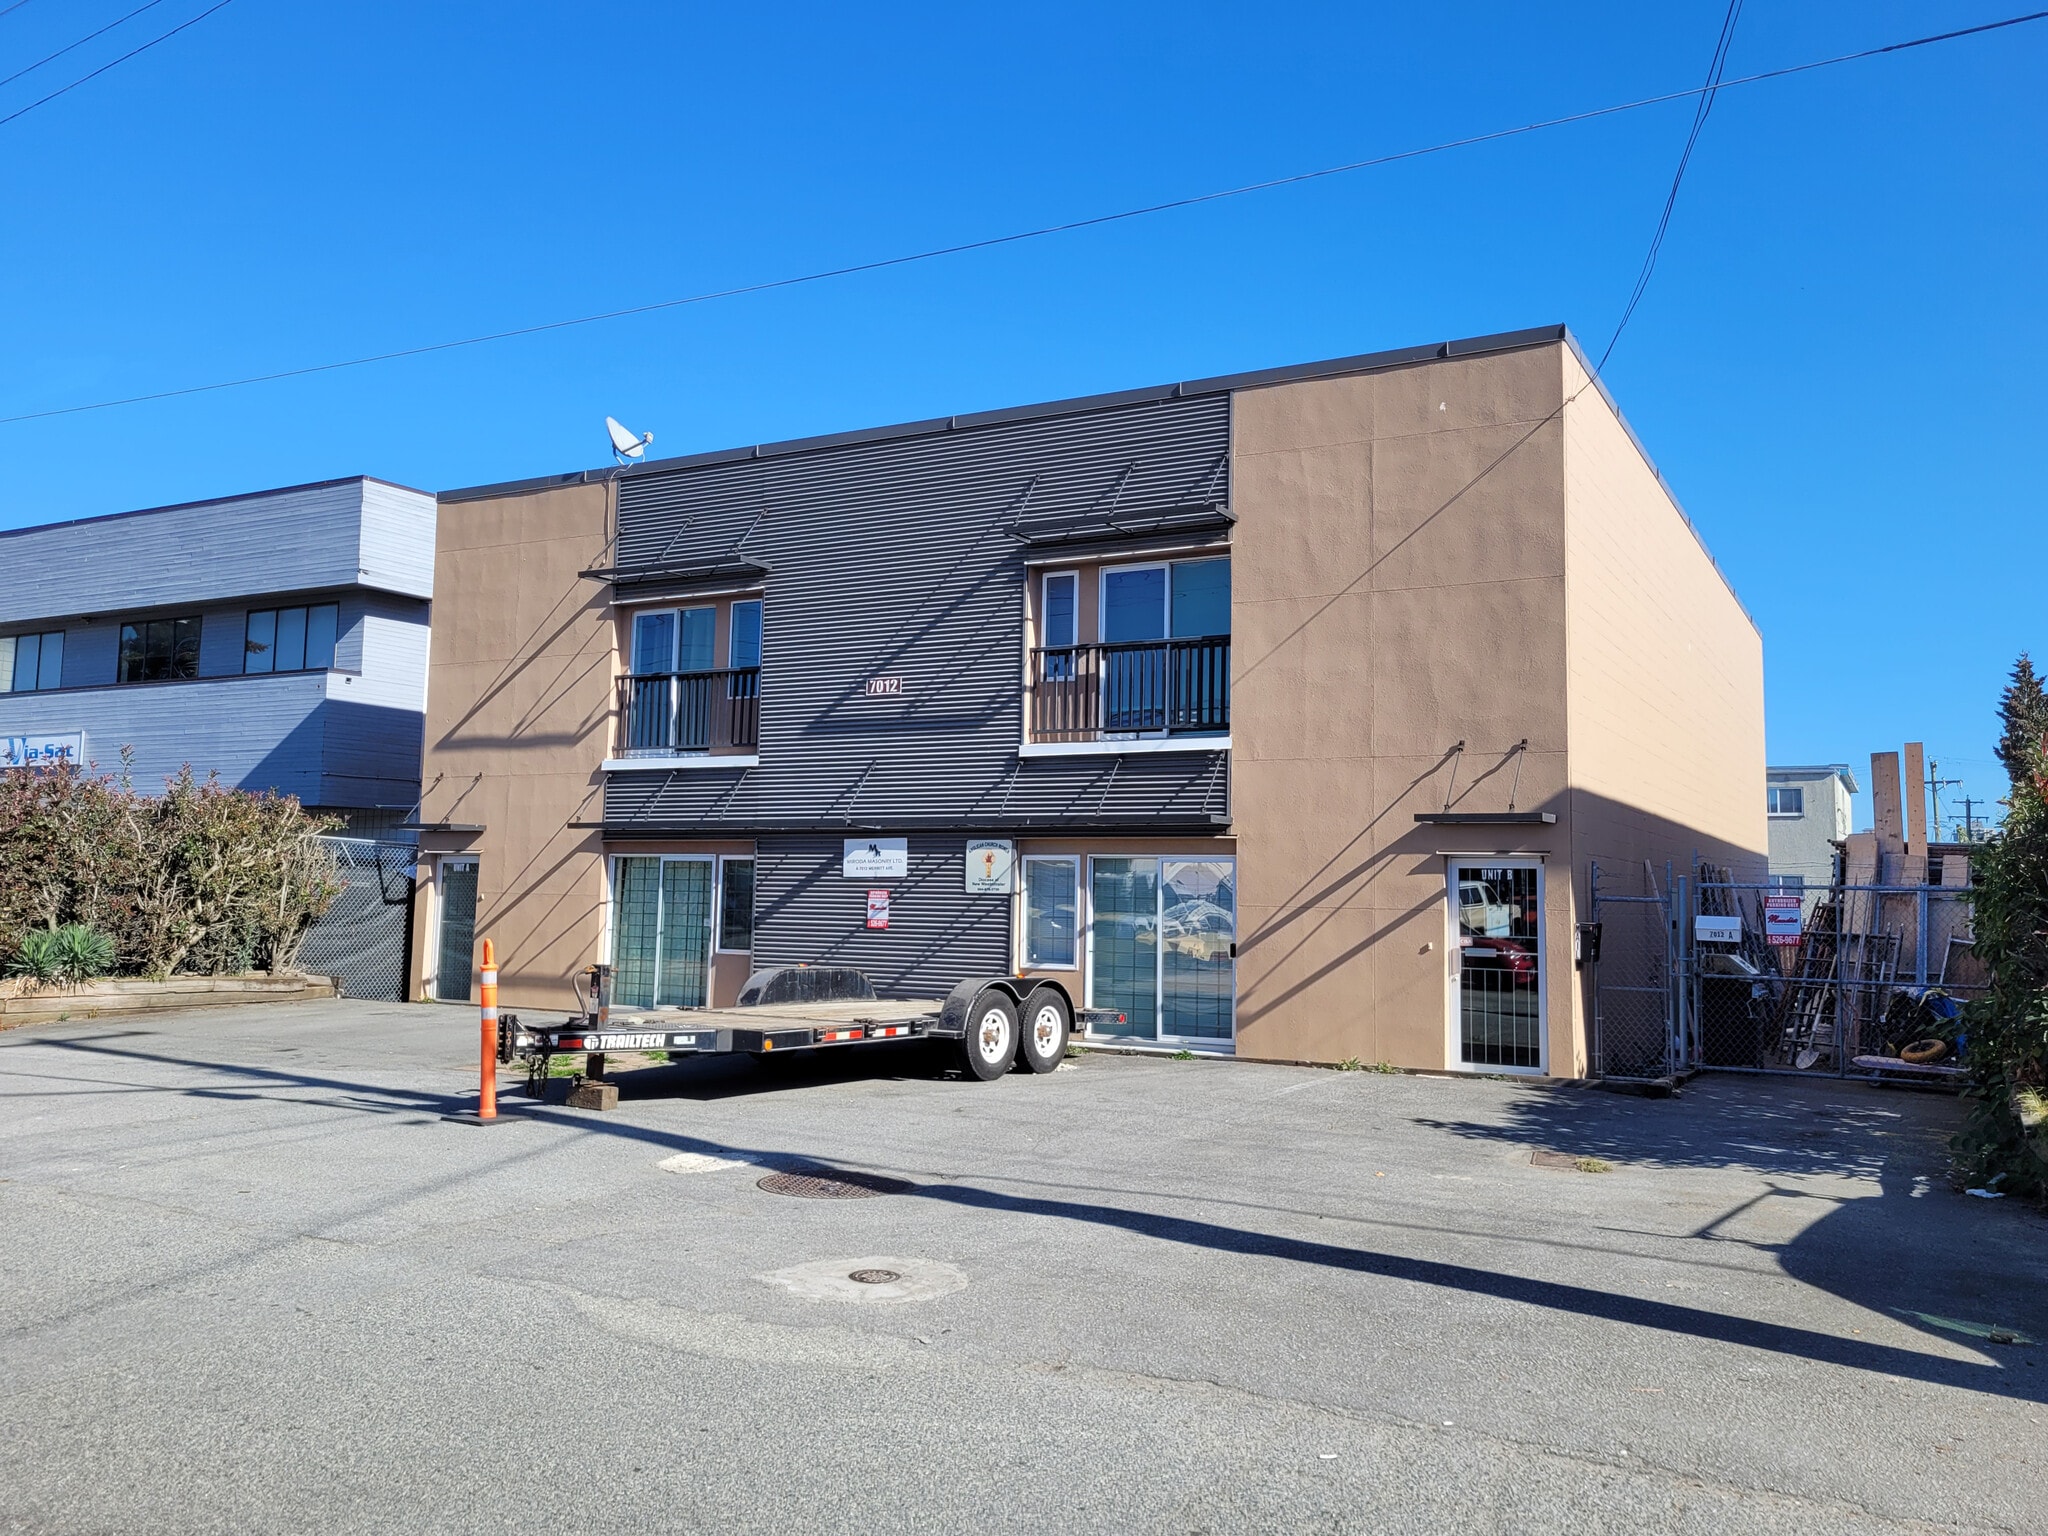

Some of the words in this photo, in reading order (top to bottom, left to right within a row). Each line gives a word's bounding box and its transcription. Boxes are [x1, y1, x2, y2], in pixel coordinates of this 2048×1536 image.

[870, 679, 898, 693] 7012
[8, 737, 74, 765] Via-Sat
[1481, 869, 1503, 880] UNIT
[1507, 870, 1513, 880] B
[1728, 931, 1734, 940] A
[1771, 935, 1800, 944] 526-9677
[600, 1033, 666, 1049] TRAILTECH
